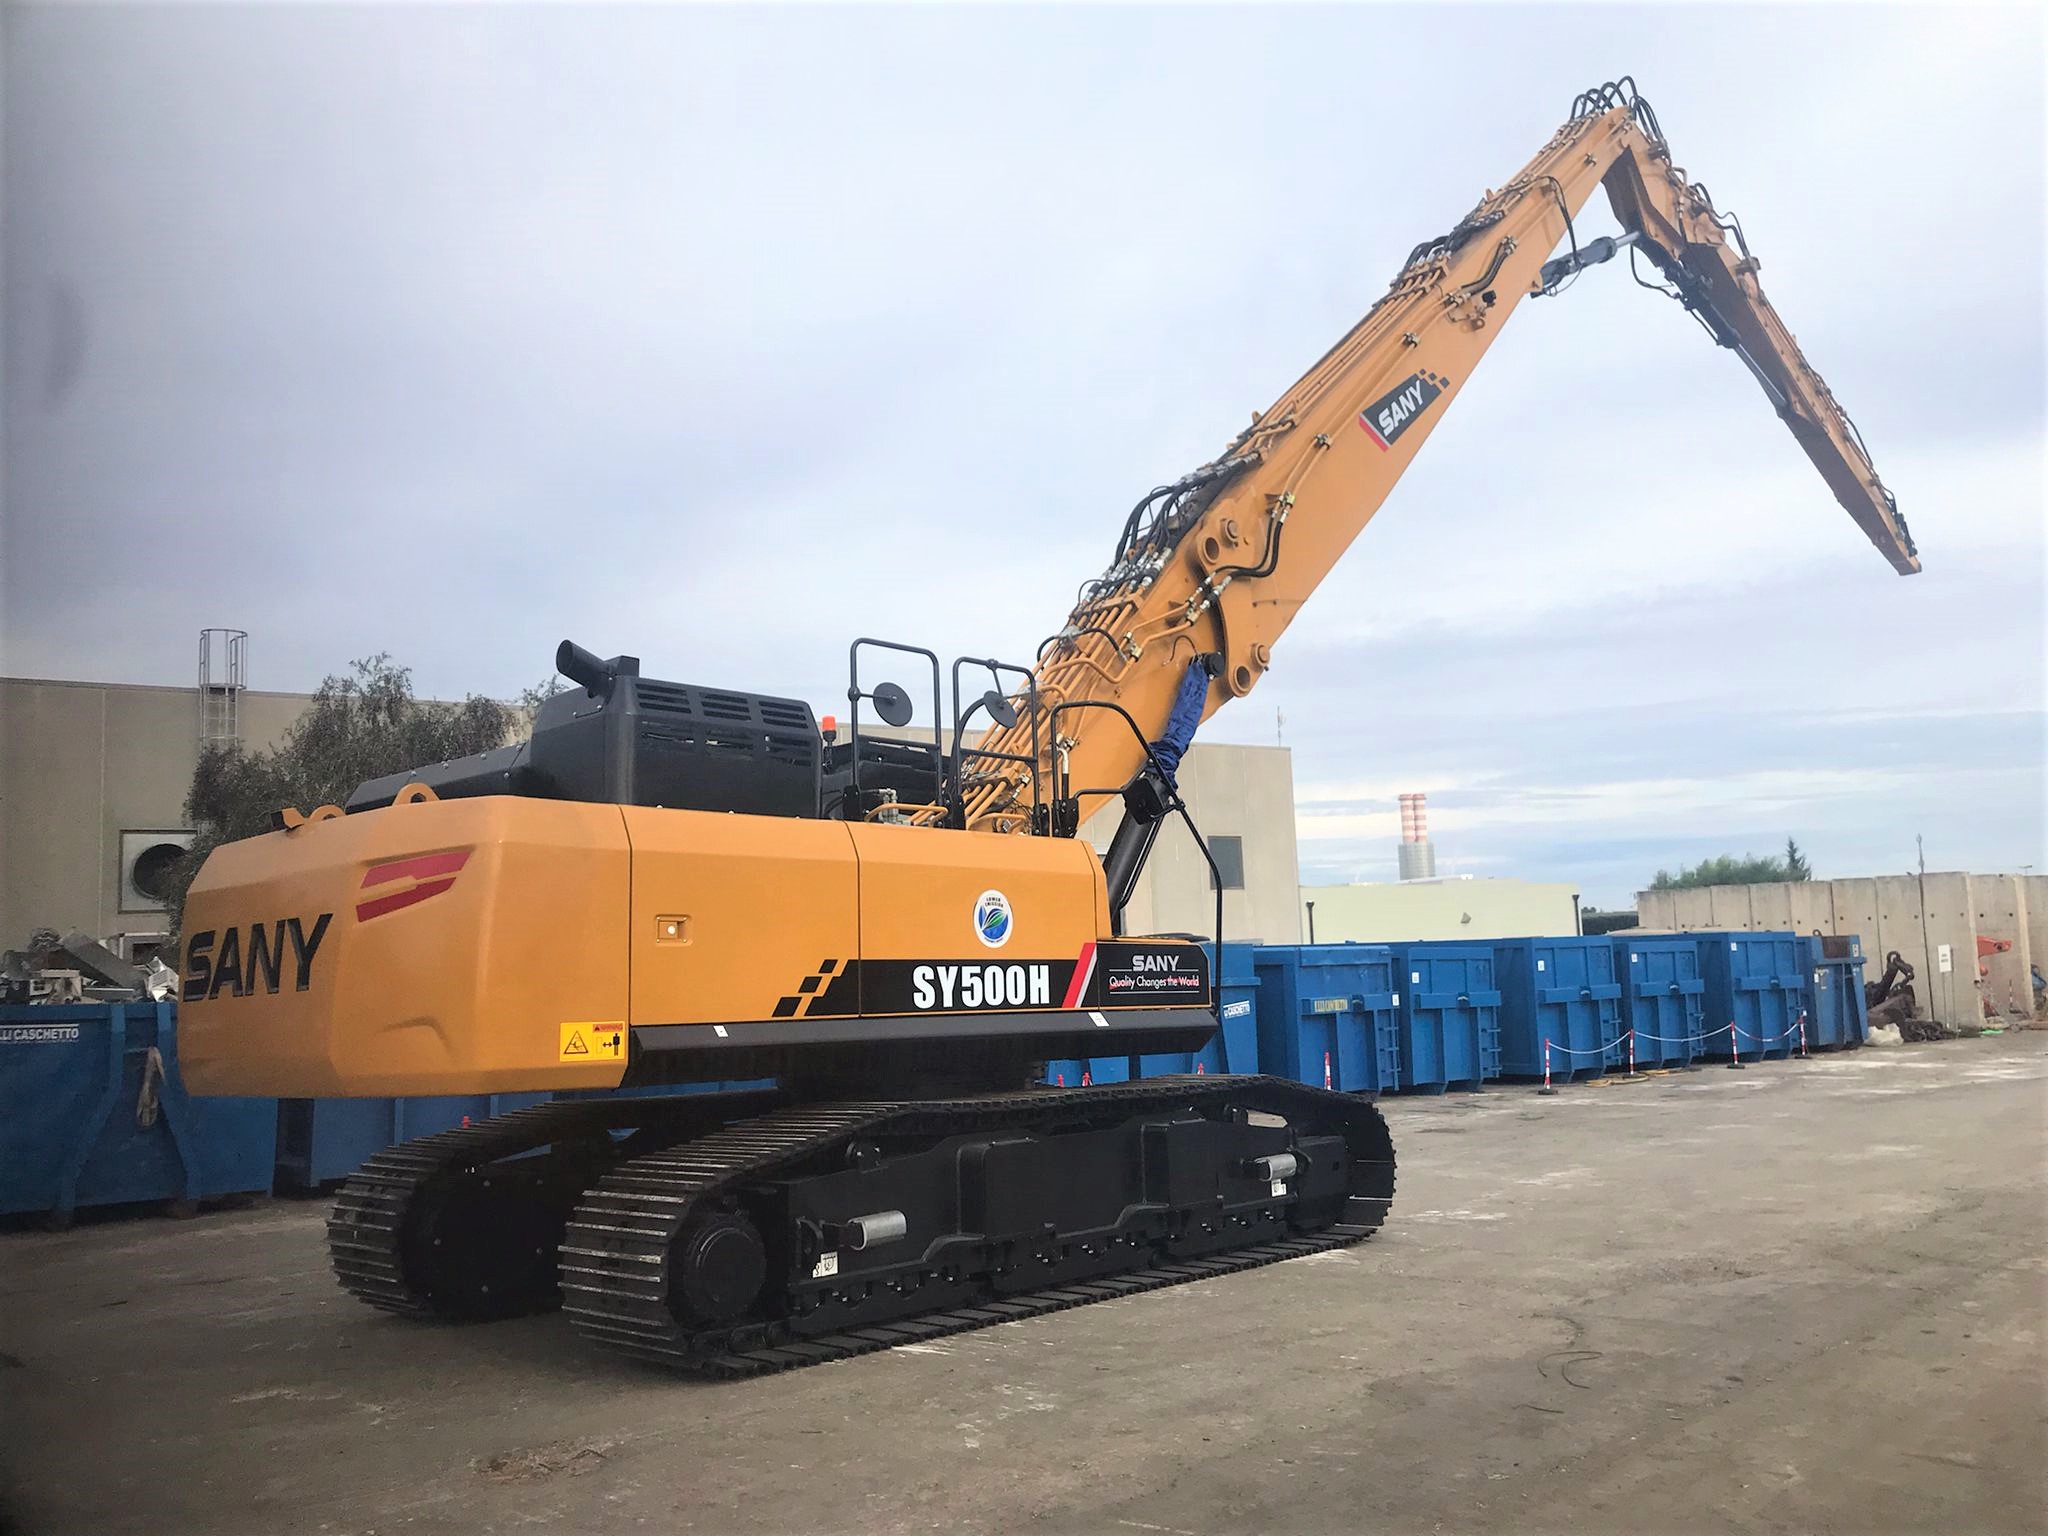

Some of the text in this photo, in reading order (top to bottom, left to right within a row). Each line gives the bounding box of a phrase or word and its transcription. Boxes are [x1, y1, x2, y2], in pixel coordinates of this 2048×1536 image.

[1378, 380, 1424, 437] SANY
[182, 912, 334, 1003] SANY
[1132, 955, 1180, 972] SANY
[912, 964, 1050, 1009] SY500H
[1109, 975, 1200, 990] Quality Changes the World
[14, 1028, 79, 1040] CASCHETTO
